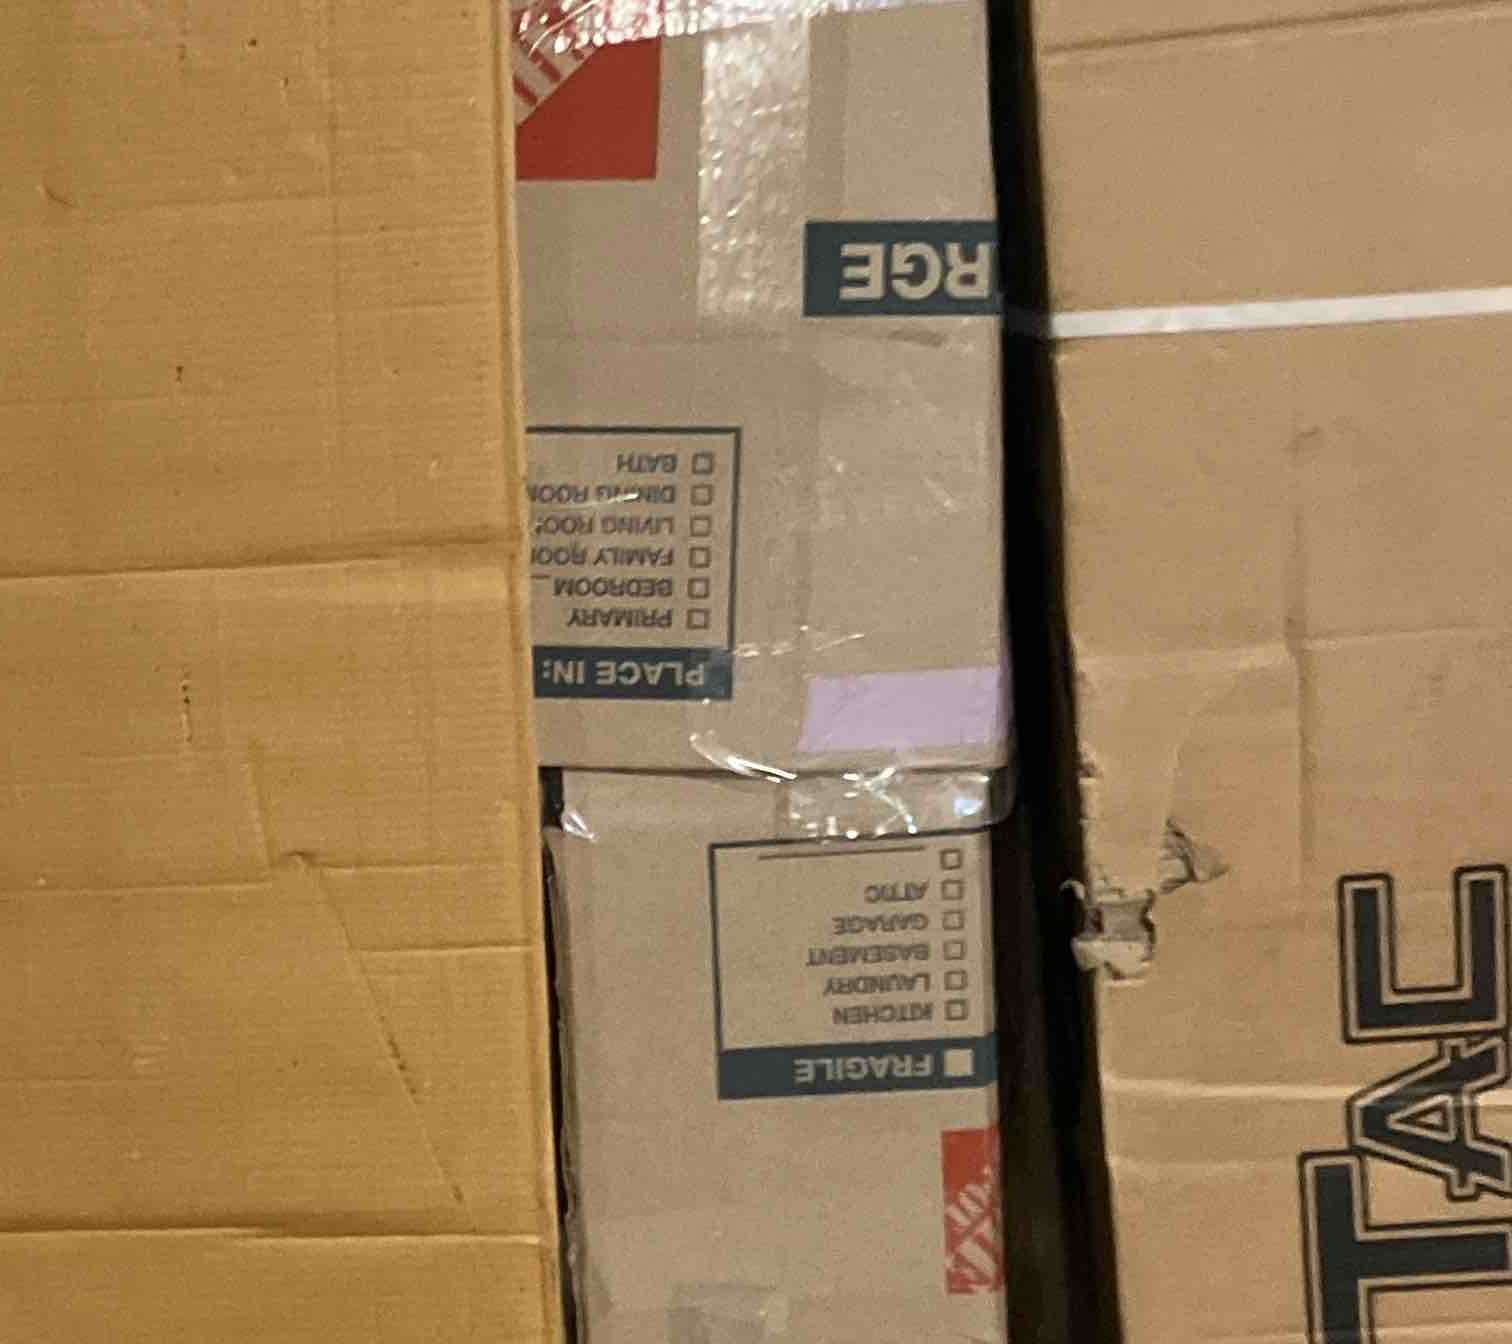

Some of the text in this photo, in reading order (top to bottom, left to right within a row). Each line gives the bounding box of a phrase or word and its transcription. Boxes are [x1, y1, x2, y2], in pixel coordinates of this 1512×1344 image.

[616, 453, 679, 473] BATH
[601, 516, 675, 535] LIVING
[593, 547, 675, 567] FAMILY
[552, 577, 674, 598] BEDROOM
[566, 607, 673, 628] PRIMARY
[541, 659, 706, 686] PLACE IN:
[864, 879, 930, 903] ATTIC
[832, 913, 929, 935] GARAGE
[805, 943, 931, 967] BASEMENT
[822, 973, 931, 996] LAUNDRY
[832, 1003, 934, 1025] KITCHEN
[793, 1054, 934, 1084] FRAGILE
